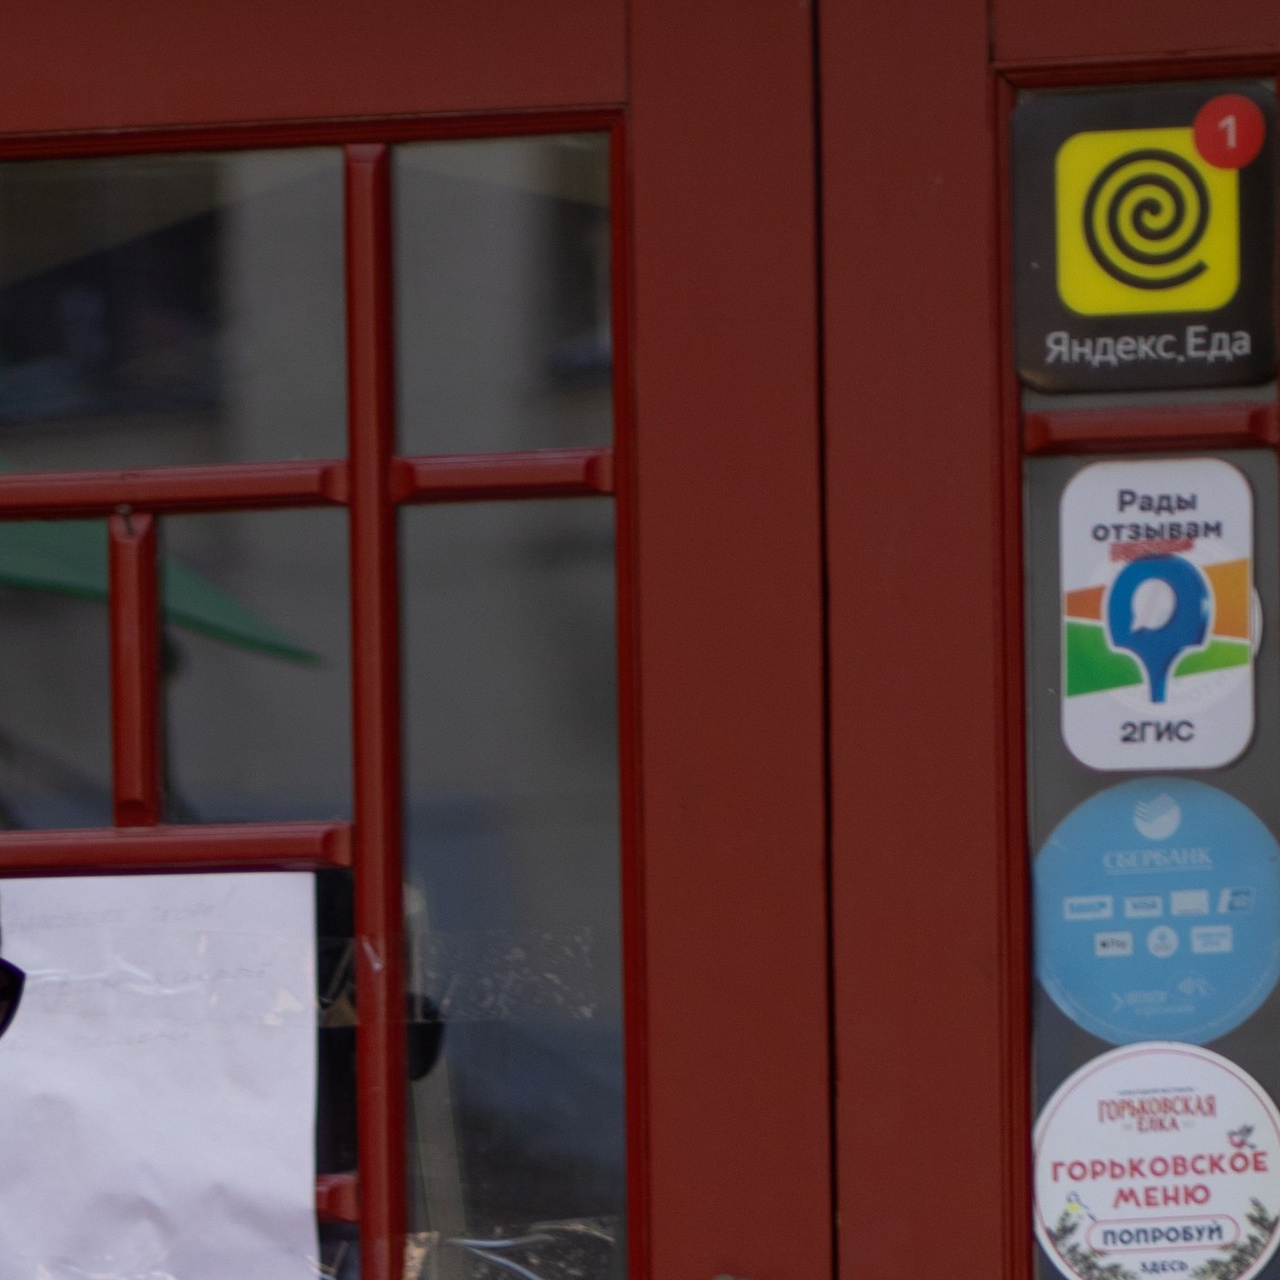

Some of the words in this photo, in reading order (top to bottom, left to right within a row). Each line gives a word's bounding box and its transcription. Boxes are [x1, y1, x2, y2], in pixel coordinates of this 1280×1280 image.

[1217, 115, 1238, 149] 1
[1117, 490, 1198, 513] Рады
[1091, 520, 1223, 542] отзывам
[1120, 721, 1195, 743] 2ГИС
[1051, 1151, 1269, 1182] ГОРЬКОВСКОЕ
[1113, 1184, 1211, 1209] МЕНЮ
[1102, 1221, 1223, 1246] ПОПРОБУЙ
[1140, 1260, 1188, 1275] ЗДЕСЬ
